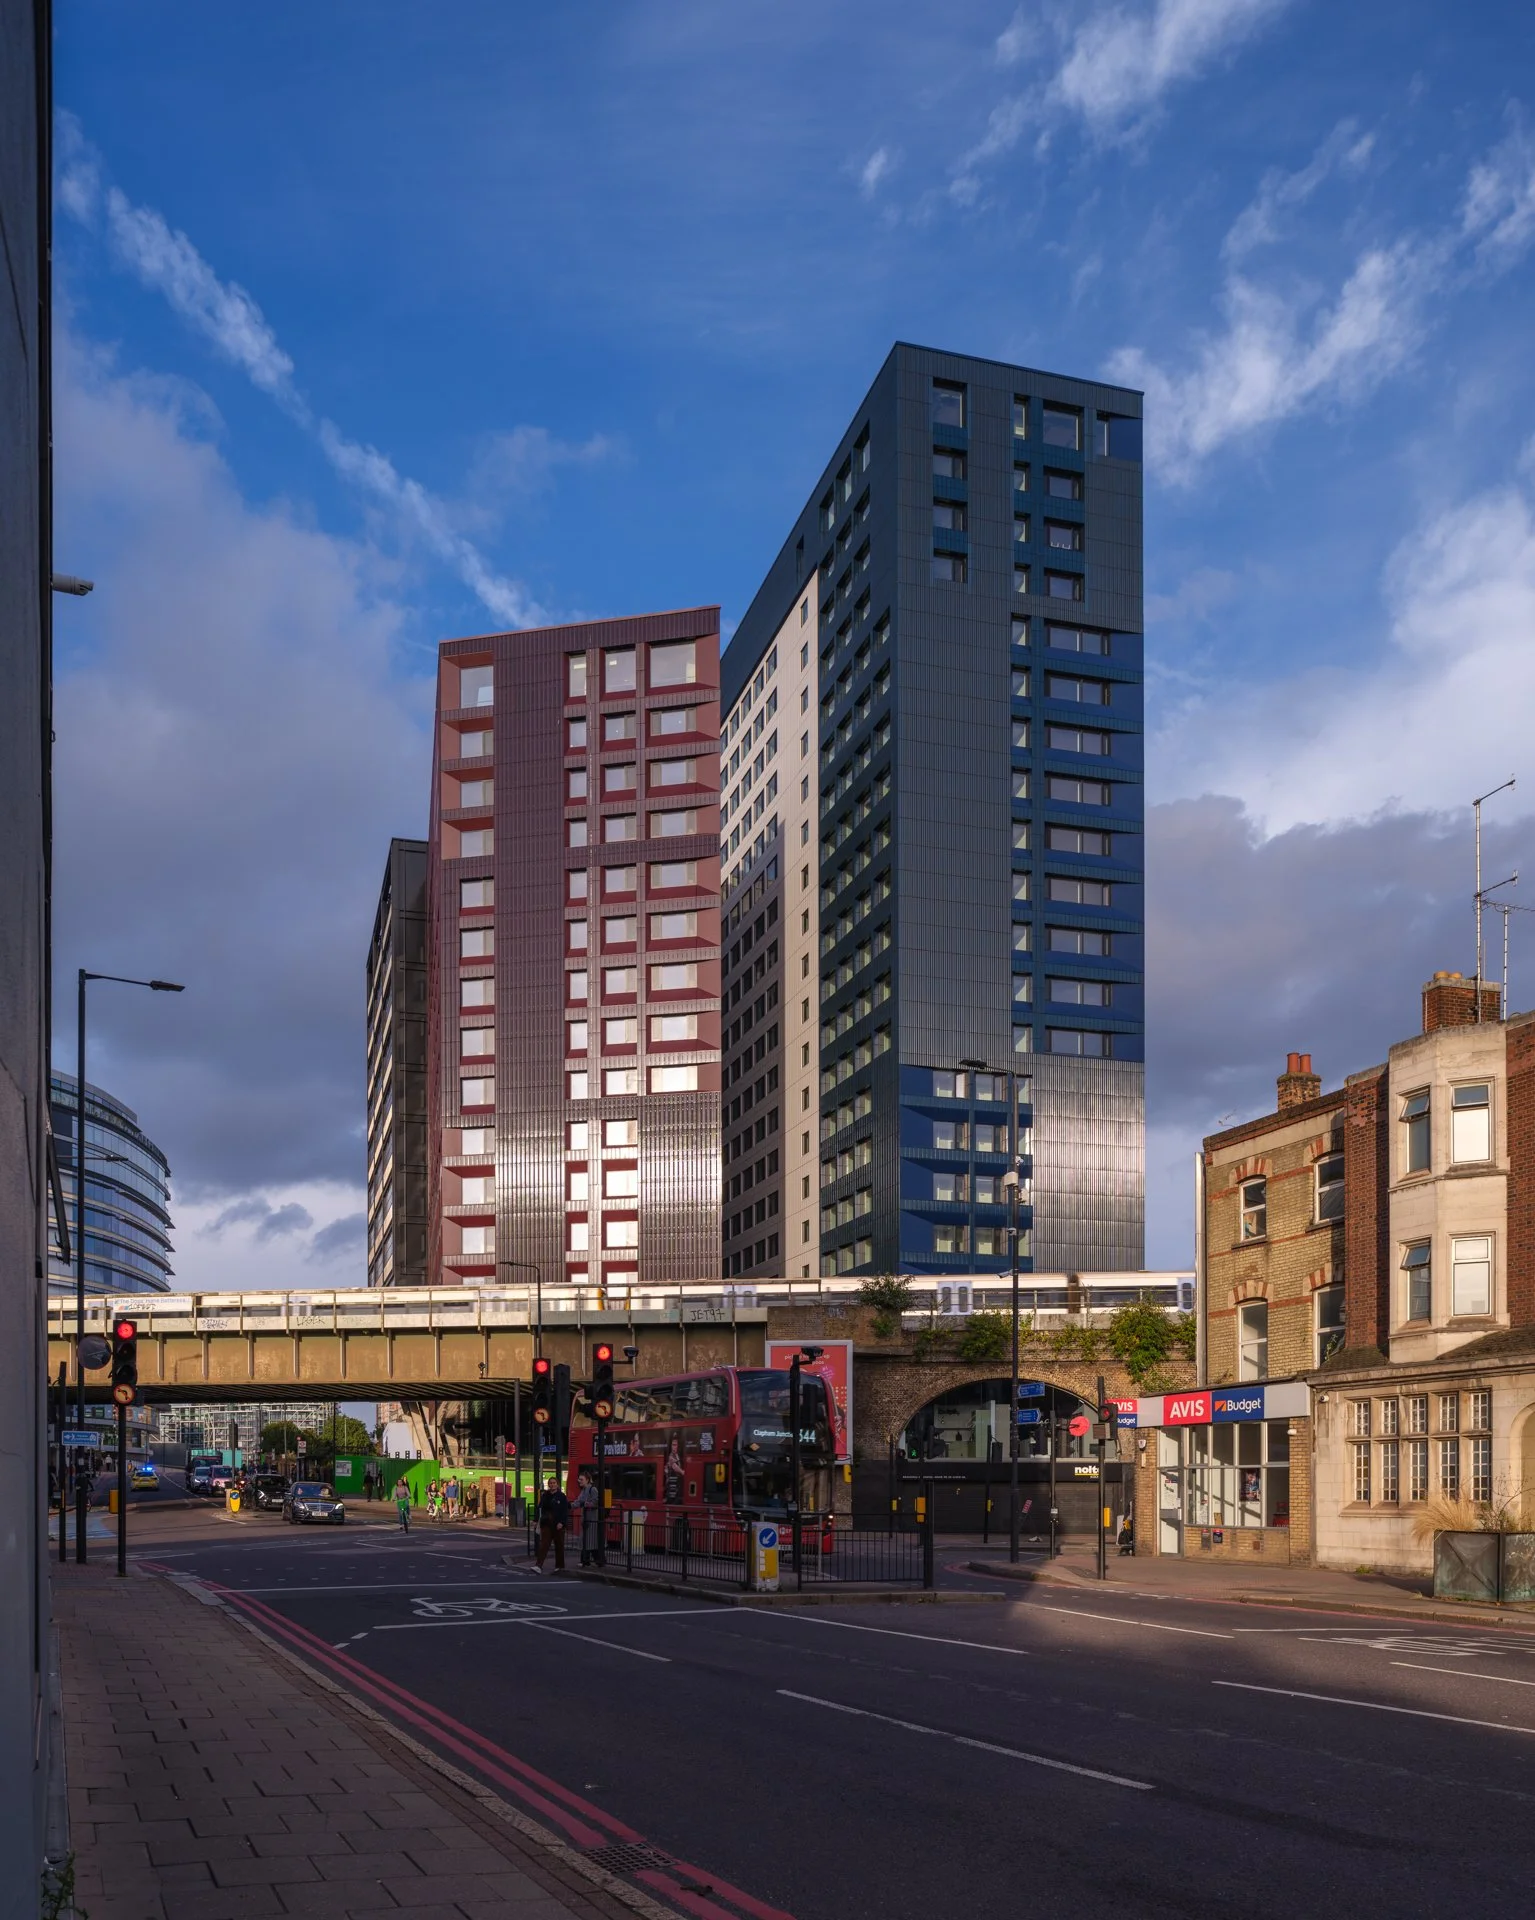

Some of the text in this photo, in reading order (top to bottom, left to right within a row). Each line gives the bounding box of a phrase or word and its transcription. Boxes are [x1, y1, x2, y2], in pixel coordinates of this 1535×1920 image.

[1113, 1401, 1133, 1411] VIS
[1169, 1399, 1205, 1418] AVIS
[1226, 1397, 1261, 1414] Budget
[753, 1429, 793, 1438] Clapham Junctio
[604, 1440, 627, 1455] raviata
